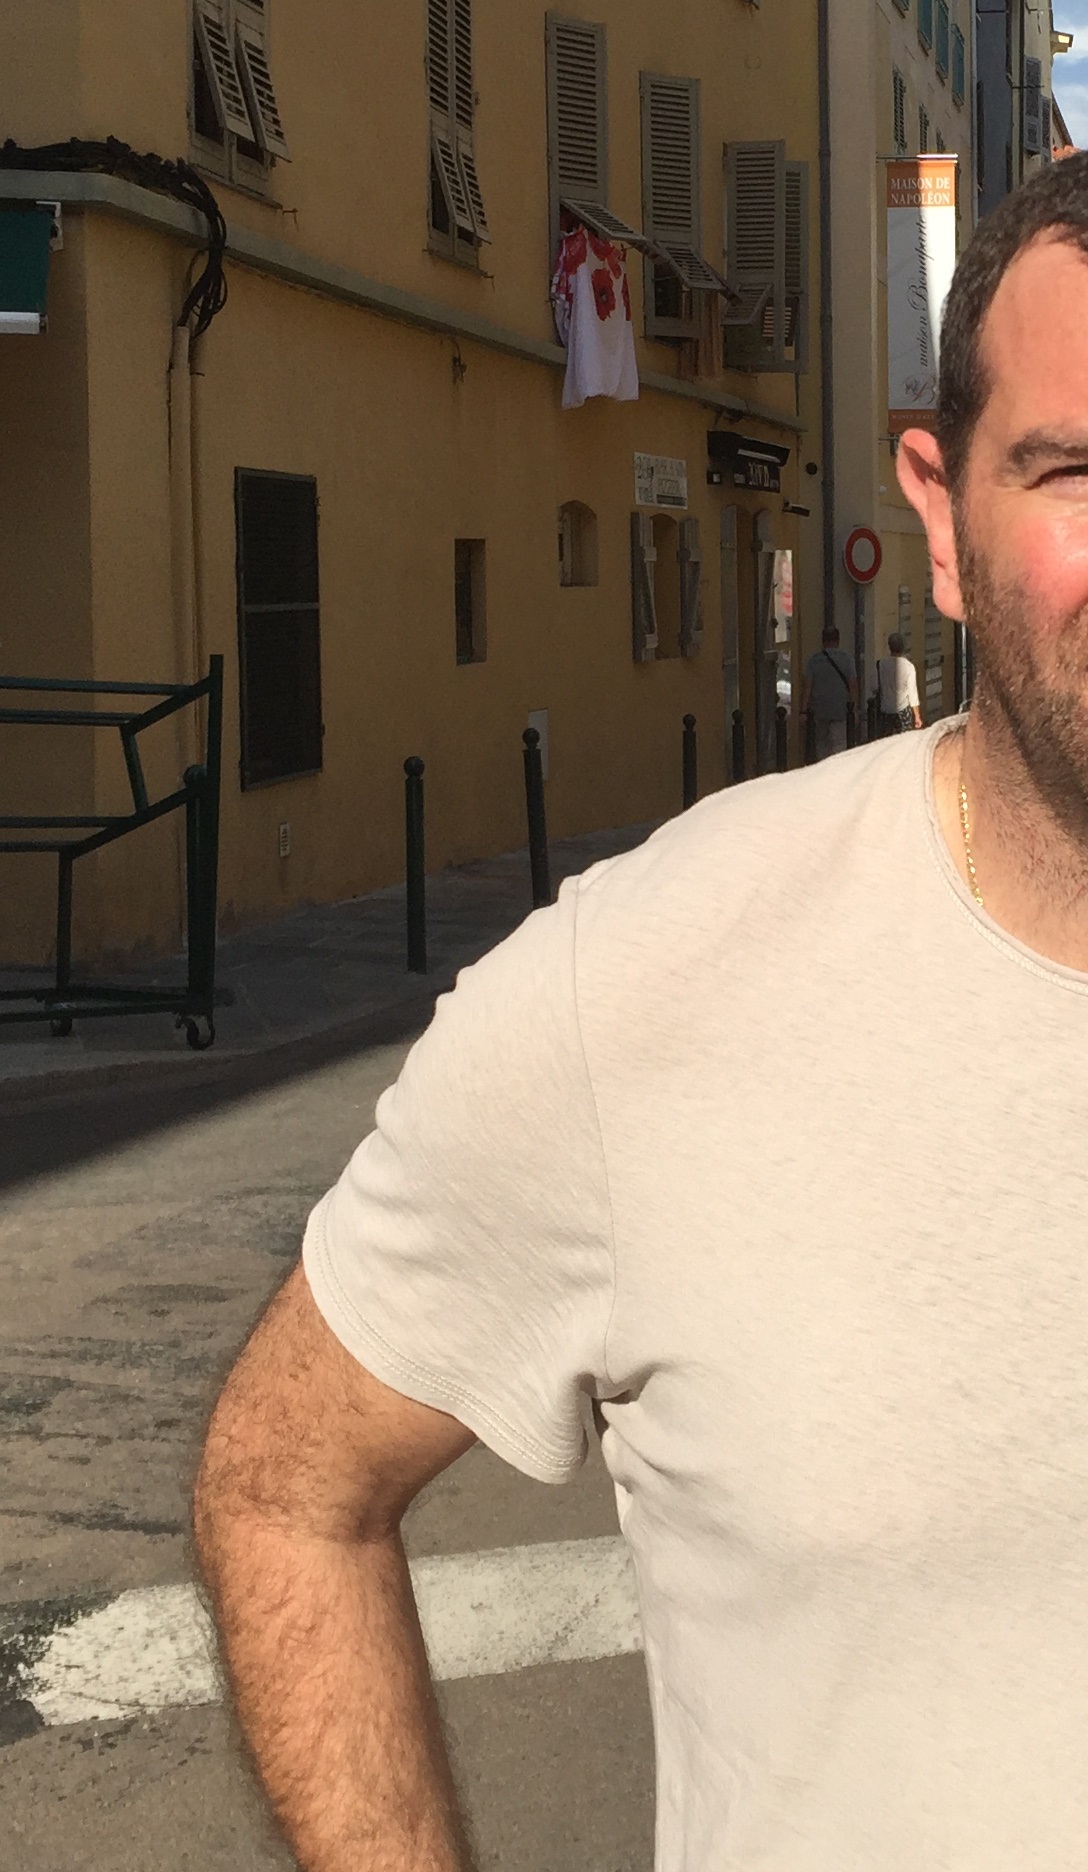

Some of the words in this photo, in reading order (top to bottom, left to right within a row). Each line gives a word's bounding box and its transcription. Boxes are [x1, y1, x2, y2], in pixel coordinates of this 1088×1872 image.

[890, 177, 932, 190] MAISON
[935, 177, 950, 190] DE
[890, 191, 951, 205] NAPOLÉON
